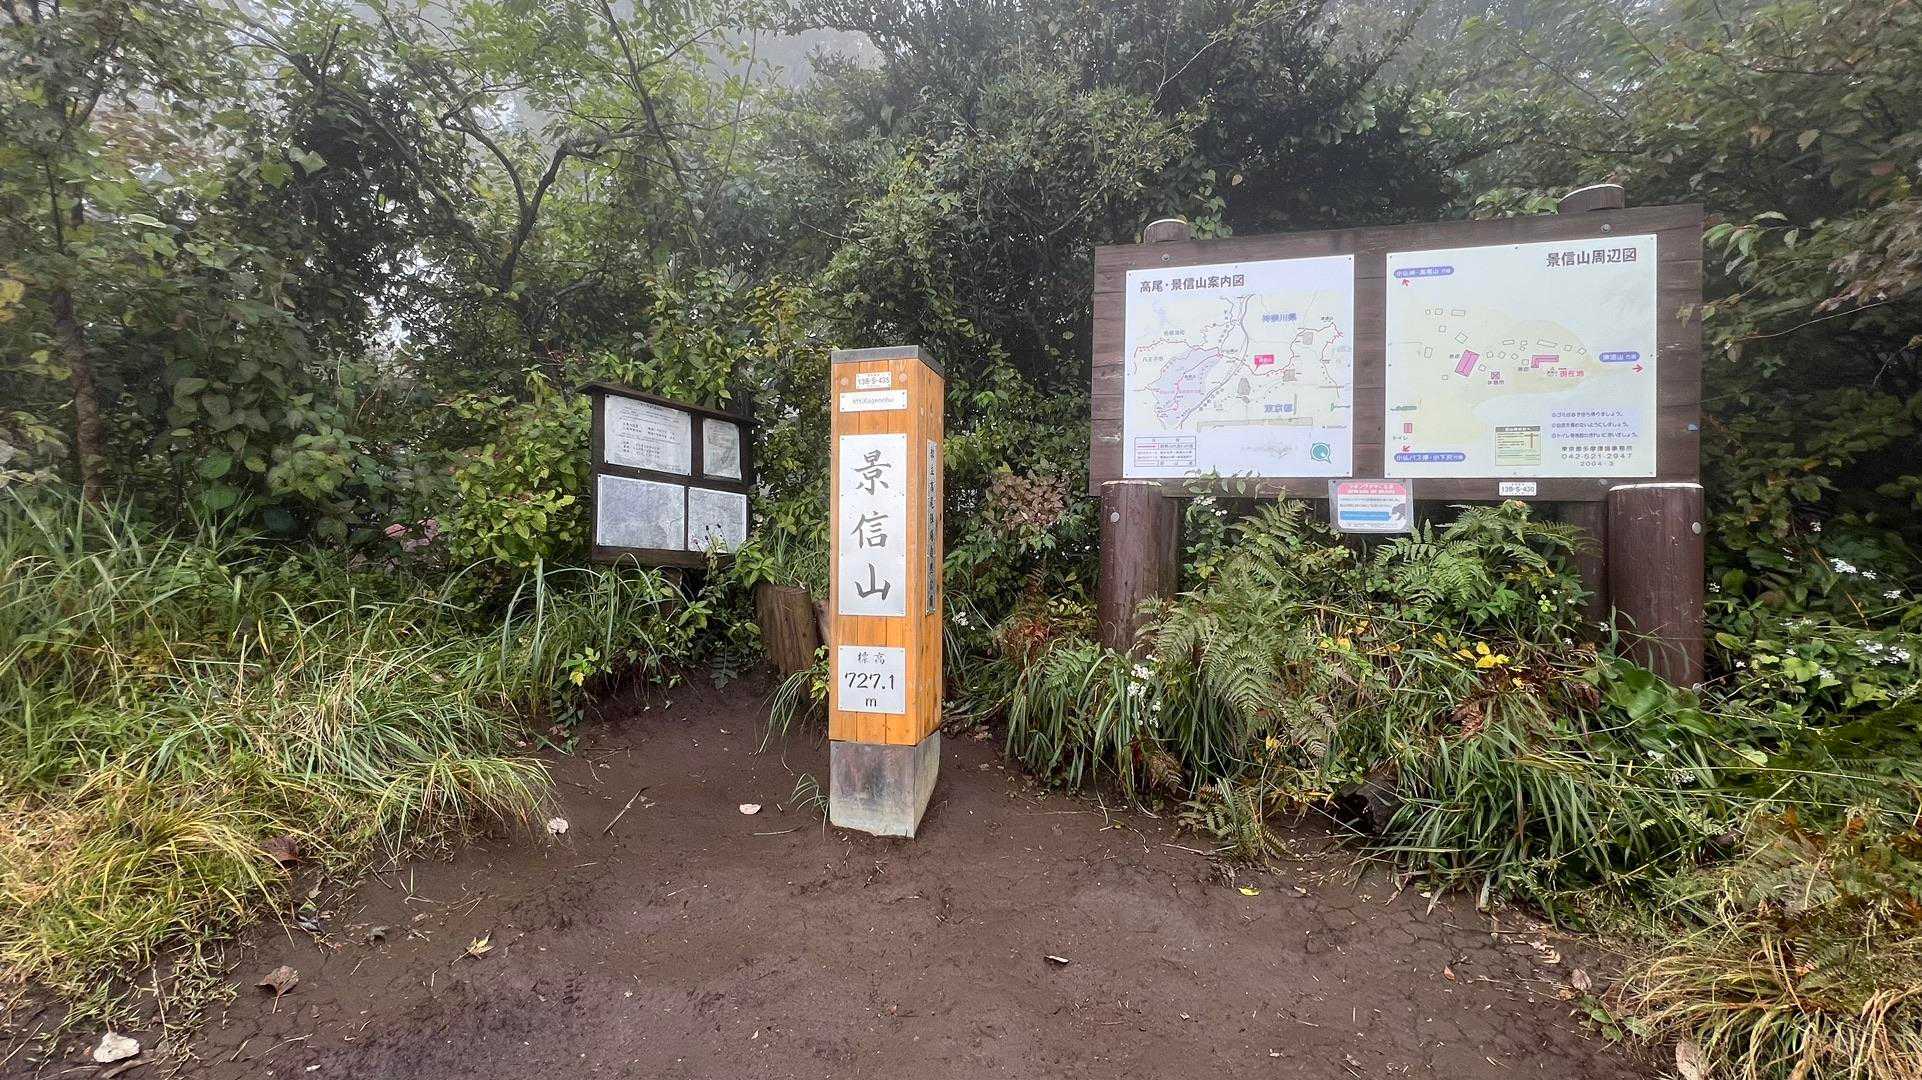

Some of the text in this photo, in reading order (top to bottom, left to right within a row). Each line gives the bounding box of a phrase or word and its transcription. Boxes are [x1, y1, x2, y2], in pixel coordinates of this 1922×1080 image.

[1546, 248, 1637, 268] 景信山周辺図
[1139, 275, 1245, 296] 高尾・景信山案内図
[1559, 370, 1584, 378] 現在地
[852, 449, 892, 602] 景信山
[857, 651, 887, 665] 標高
[844, 672, 895, 690] 727.1
[864, 697, 878, 707] m
